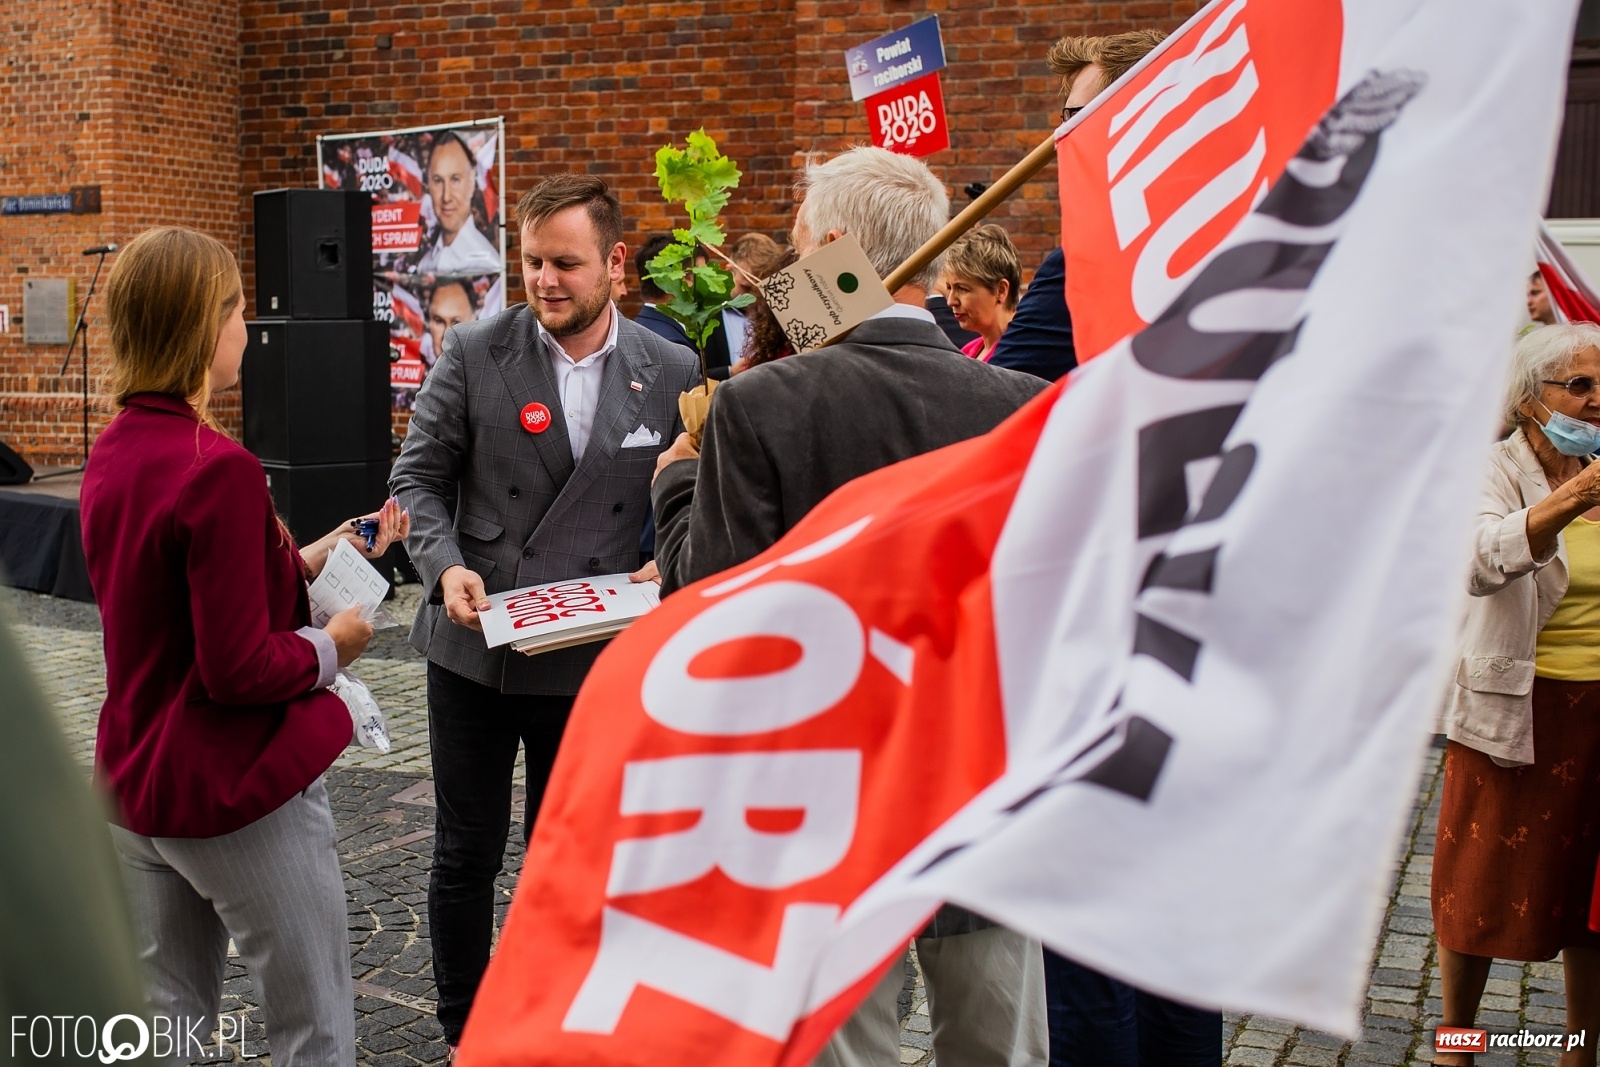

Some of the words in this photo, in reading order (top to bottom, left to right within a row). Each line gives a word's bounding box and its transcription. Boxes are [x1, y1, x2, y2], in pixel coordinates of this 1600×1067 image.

[876, 37, 912, 63] Powiat
[873, 55, 923, 87] raciborski
[877, 90, 933, 127] DUDA
[880, 110, 937, 148] 2020
[358, 156, 391, 174] DUDA
[360, 173, 394, 191] 2020
[383, 231, 419, 246] SPRAW
[525, 409, 546, 420] DUDA
[526, 415, 547, 425] 2020
[503, 588, 560, 630] DUDA
[547, 582, 607, 618] 2020
[561, 514, 915, 1043] ÓRZ
